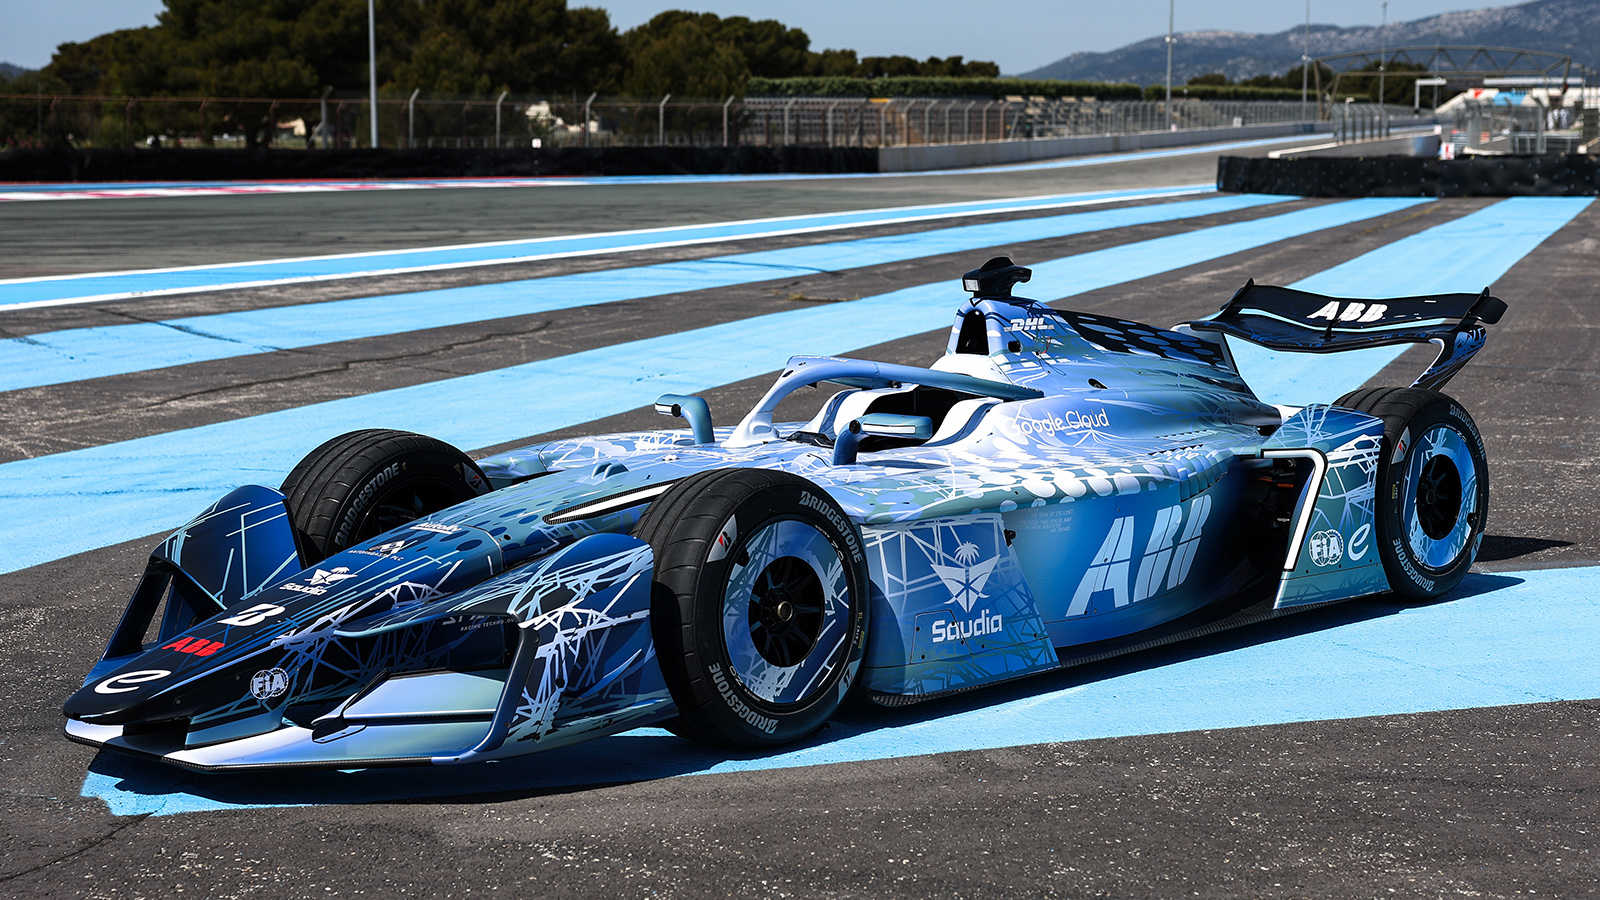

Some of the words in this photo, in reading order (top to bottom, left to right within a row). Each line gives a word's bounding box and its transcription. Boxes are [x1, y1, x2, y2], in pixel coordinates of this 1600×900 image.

[1010, 317, 1048, 331] DHL
[1306, 301, 1388, 322] ABB
[1065, 408, 1109, 429] Cloud
[1449, 404, 1486, 460] BRIDGESTONE
[334, 462, 400, 548] BRIDGESTONE
[799, 490, 862, 563] BRIDGESTONE
[1065, 494, 1212, 627] ABB
[1392, 537, 1435, 592] BRIDGESTONE
[279, 583, 328, 596] Saudia
[162, 636, 226, 657] ABB
[931, 608, 1003, 643] Saudia
[708, 662, 779, 734] BRIDGESTONE
